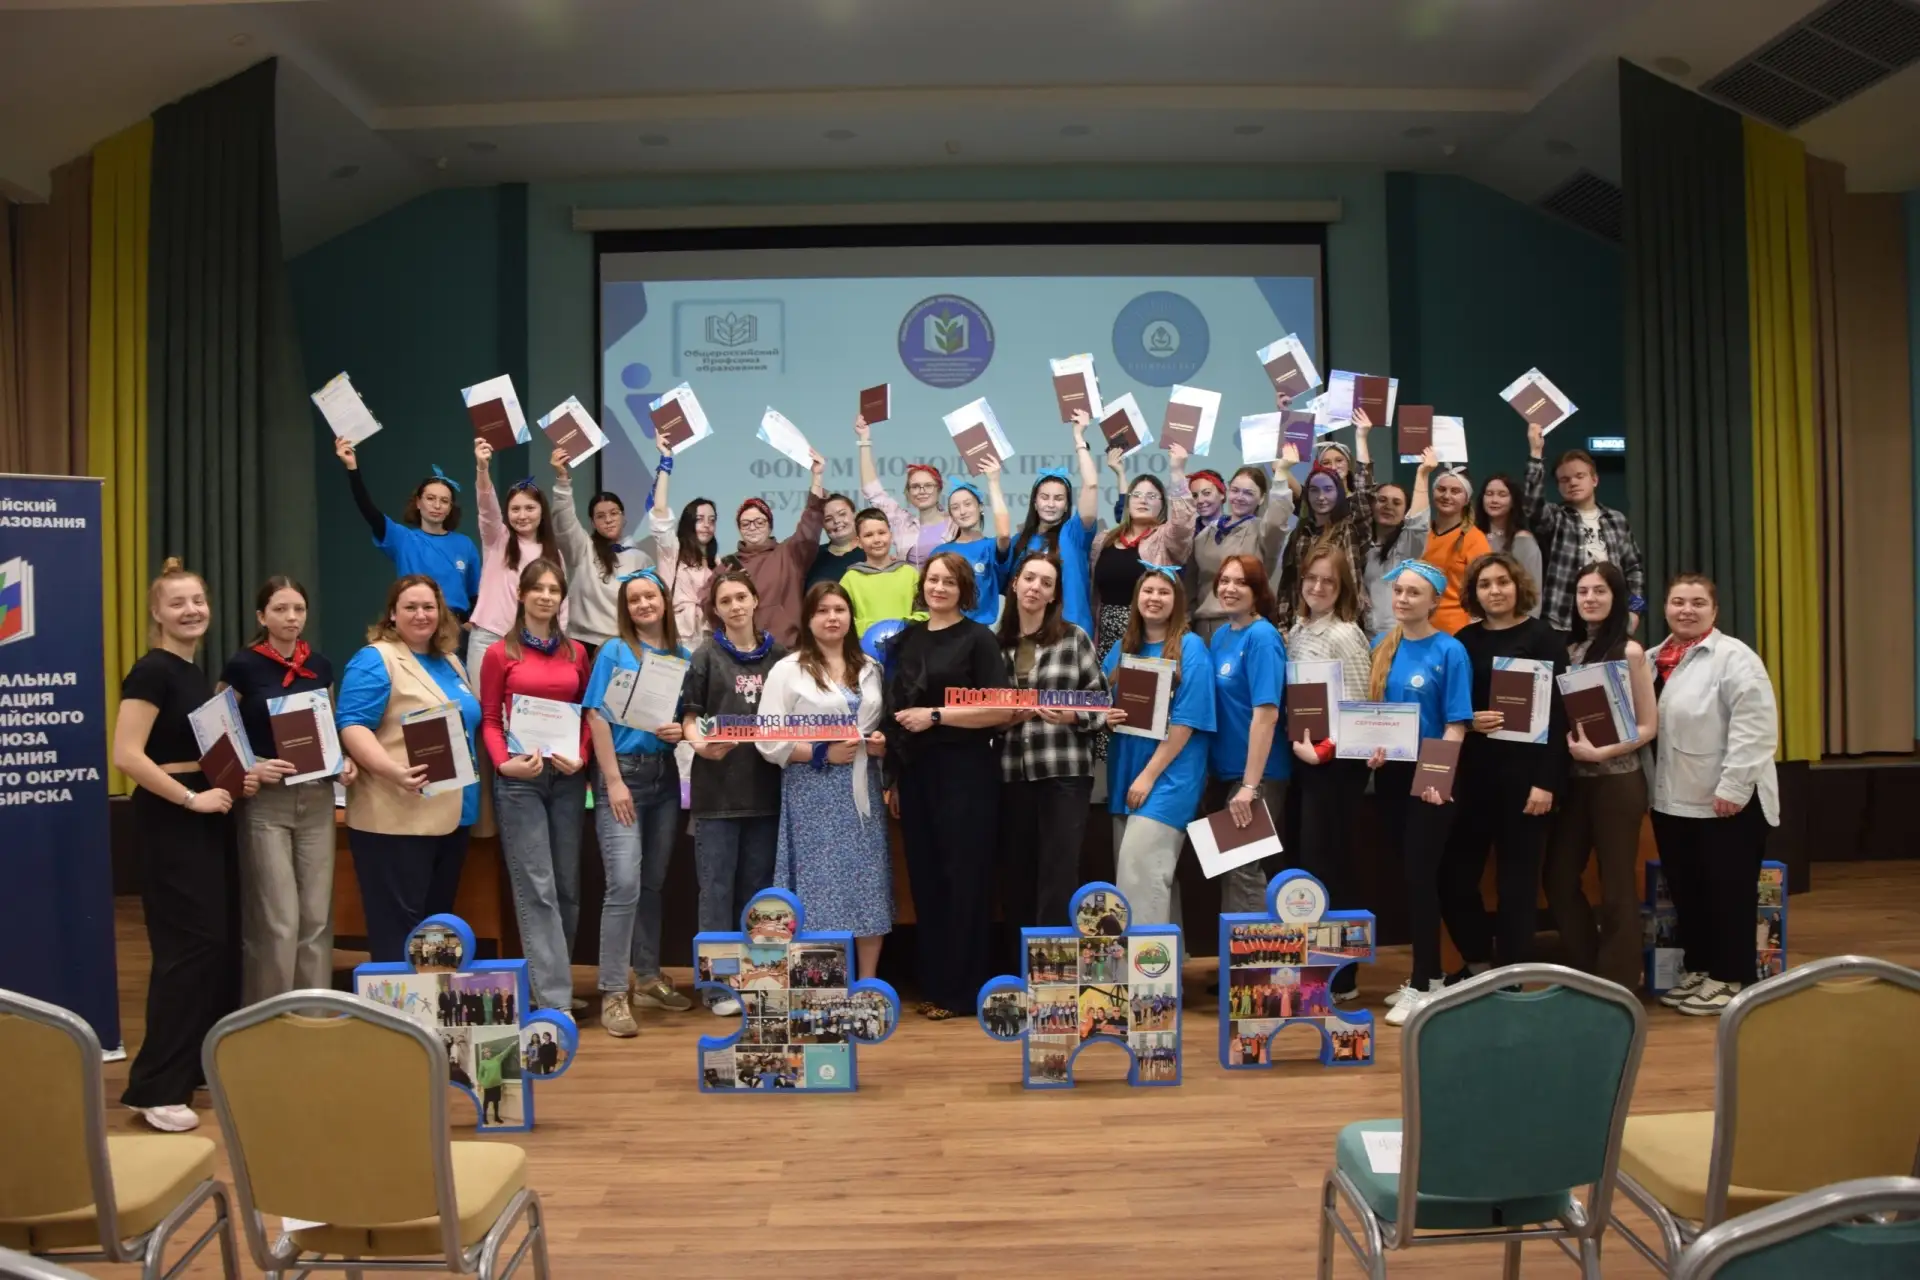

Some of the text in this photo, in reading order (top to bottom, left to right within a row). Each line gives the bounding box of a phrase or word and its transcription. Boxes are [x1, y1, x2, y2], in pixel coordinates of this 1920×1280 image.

[0, 498, 57, 512] ЙСКИЙ
[784, 714, 858, 727] ОБРАЗОВАНИЯ
[0, 732, 48, 746] ЮЗА
[0, 750, 57, 766] АНИЯ
[26, 767, 100, 784] ОКРУГА
